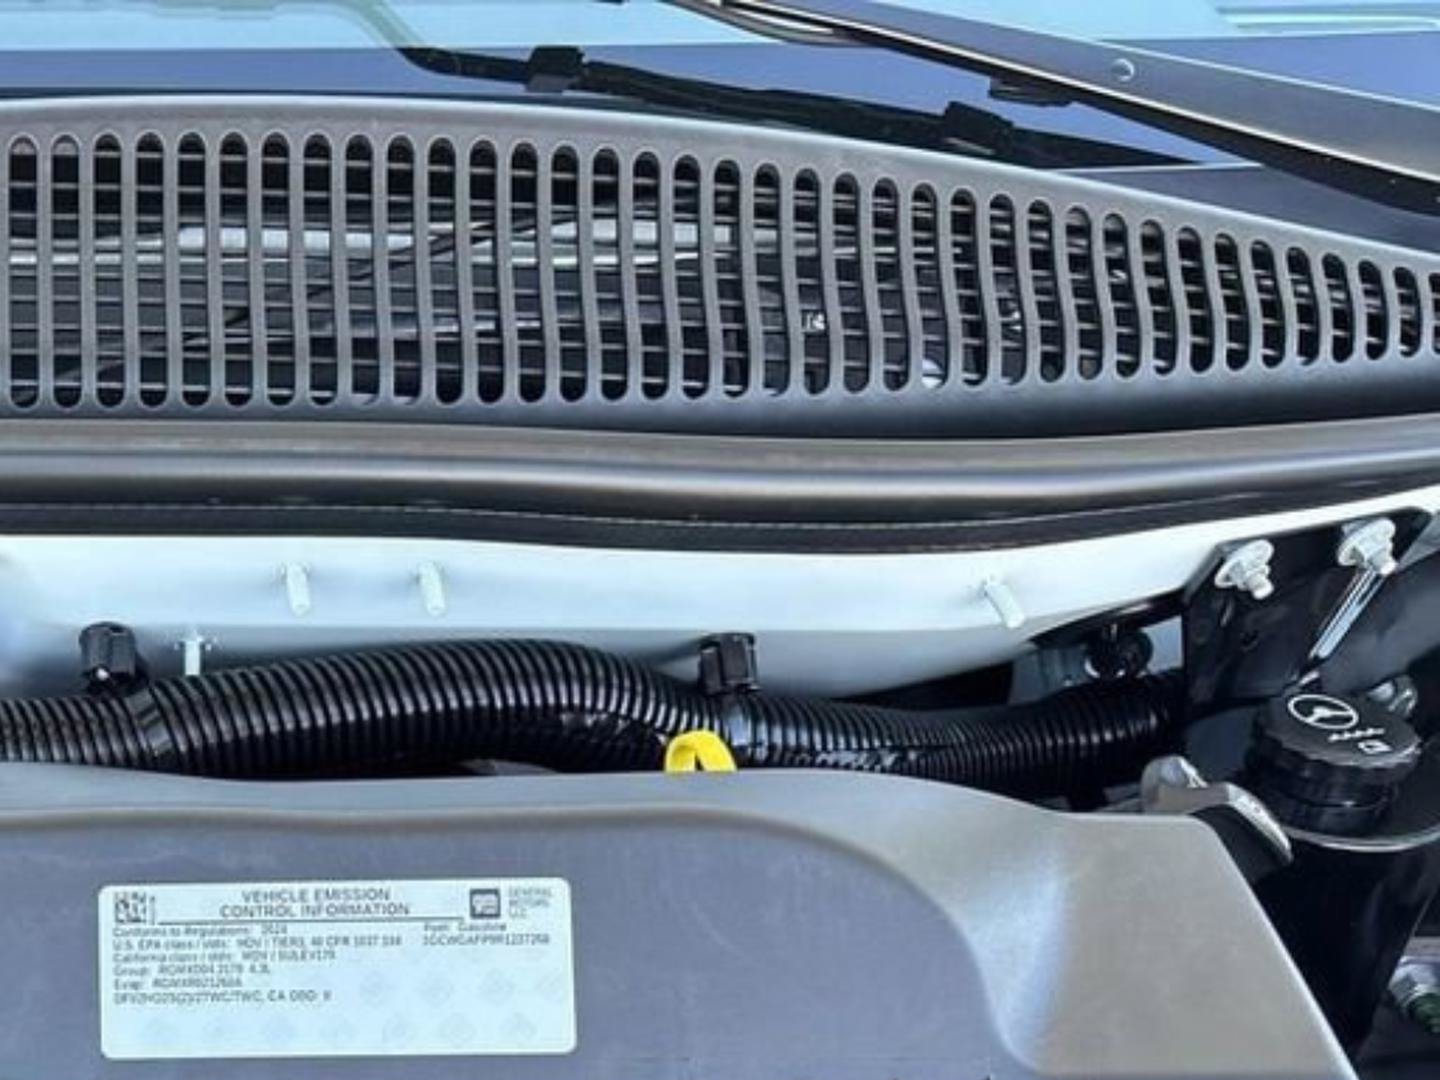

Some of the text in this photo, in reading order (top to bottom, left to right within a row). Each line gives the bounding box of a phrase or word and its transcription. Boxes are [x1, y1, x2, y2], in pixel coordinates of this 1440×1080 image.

[242, 888, 390, 902] VEHICLE EMISSION
[219, 902, 410, 917] CONTROL INFORMATION
